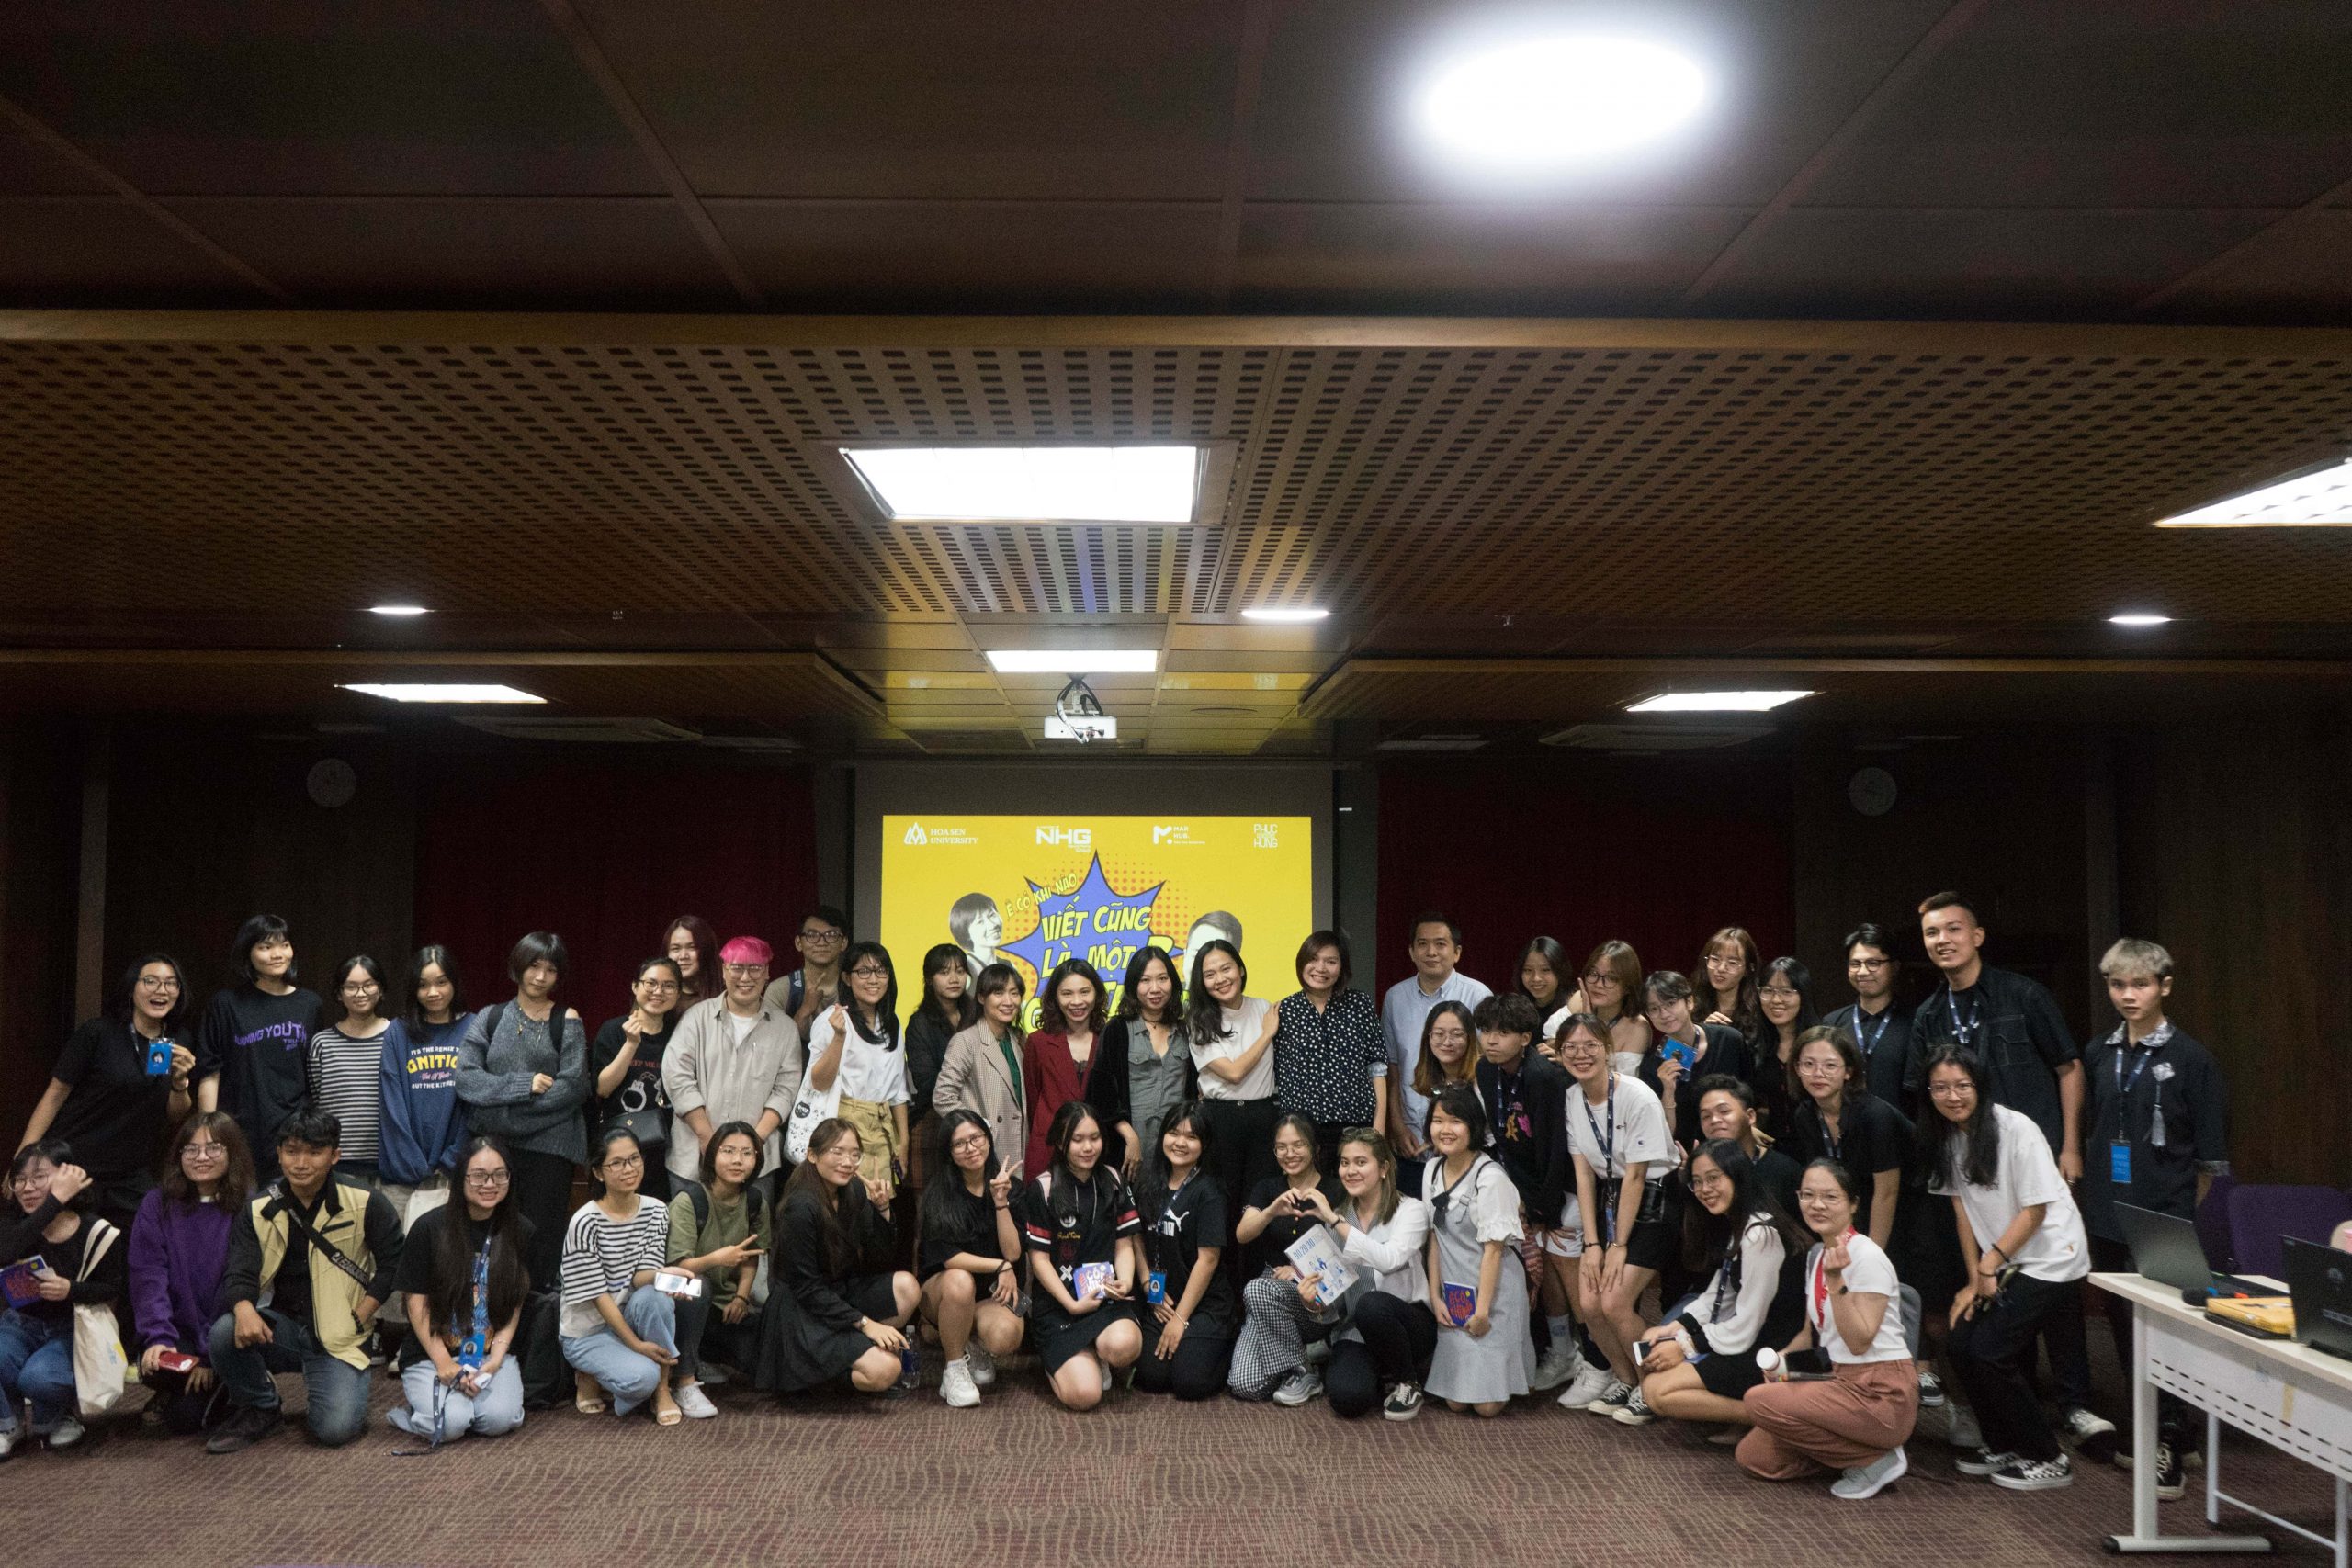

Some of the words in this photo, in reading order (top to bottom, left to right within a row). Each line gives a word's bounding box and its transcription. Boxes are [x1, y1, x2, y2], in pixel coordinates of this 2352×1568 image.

[930, 837, 978, 845] UNIVERSITY
[1036, 829, 1091, 845] NHG
[1033, 886, 1052, 905] KHI
[1093, 902, 1152, 933] CŨNG
[1087, 938, 1137, 979] MỘT
